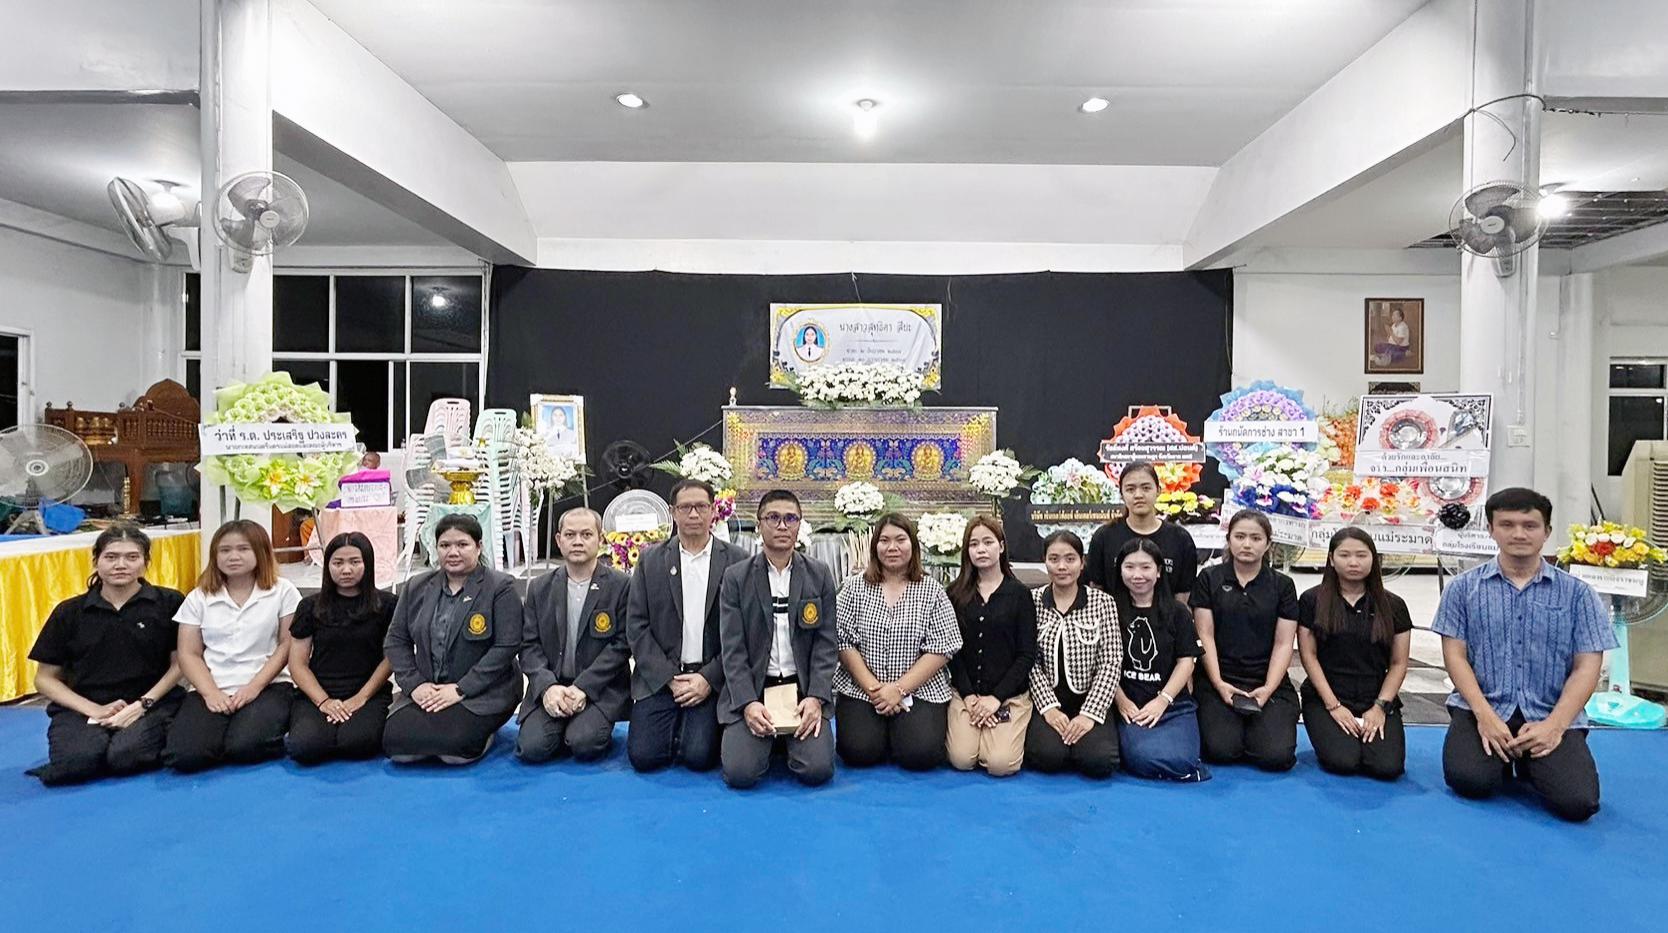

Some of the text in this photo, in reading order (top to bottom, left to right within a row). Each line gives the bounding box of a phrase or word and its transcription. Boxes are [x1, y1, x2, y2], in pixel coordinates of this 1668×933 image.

[214, 425, 236, 441] ว่าที่
[263, 428, 305, 444] ประเสริฐ
[1278, 427, 1298, 437] สาขา
[1300, 426, 1305, 437] 1
[1123, 669, 1162, 682] ICE BEAR
